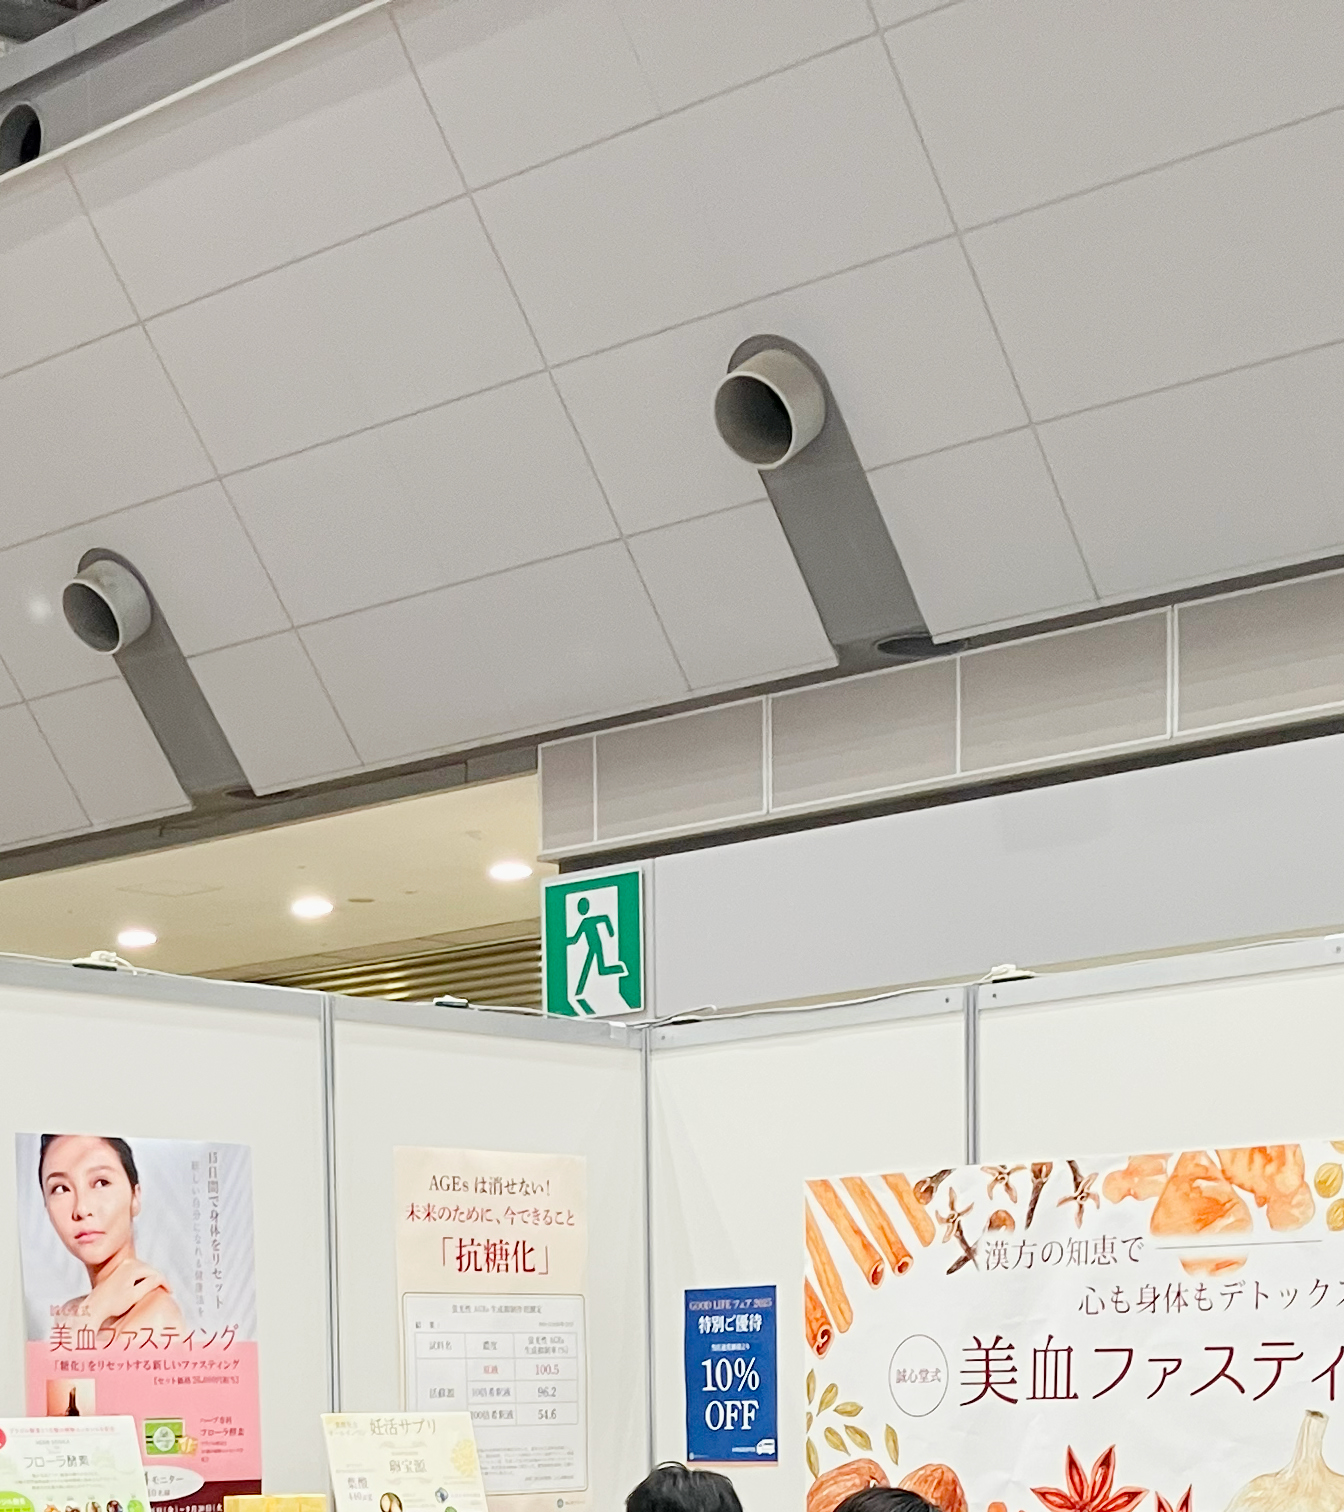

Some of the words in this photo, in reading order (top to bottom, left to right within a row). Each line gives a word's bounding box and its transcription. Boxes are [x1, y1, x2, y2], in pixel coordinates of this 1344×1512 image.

[429, 1175, 469, 1192] AGEs
[474, 1176, 551, 1197] は消せない!
[405, 1202, 576, 1227] 未来のために、今できること
[441, 1236, 550, 1276] 「抗糖化」
[984, 1234, 1145, 1271] 漢方の知恵で
[698, 1313, 763, 1335] 特別ご優待
[49, 1322, 239, 1352] 美血ファスティング
[535, 1363, 560, 1376] 100.5
[701, 1356, 760, 1393] 10%
[895, 1367, 943, 1386] 誠心堂式
[537, 1386, 557, 1398] 96.2
[705, 1399, 760, 1431] OFF
[369, 1418, 436, 1436] 妊活サプリ
